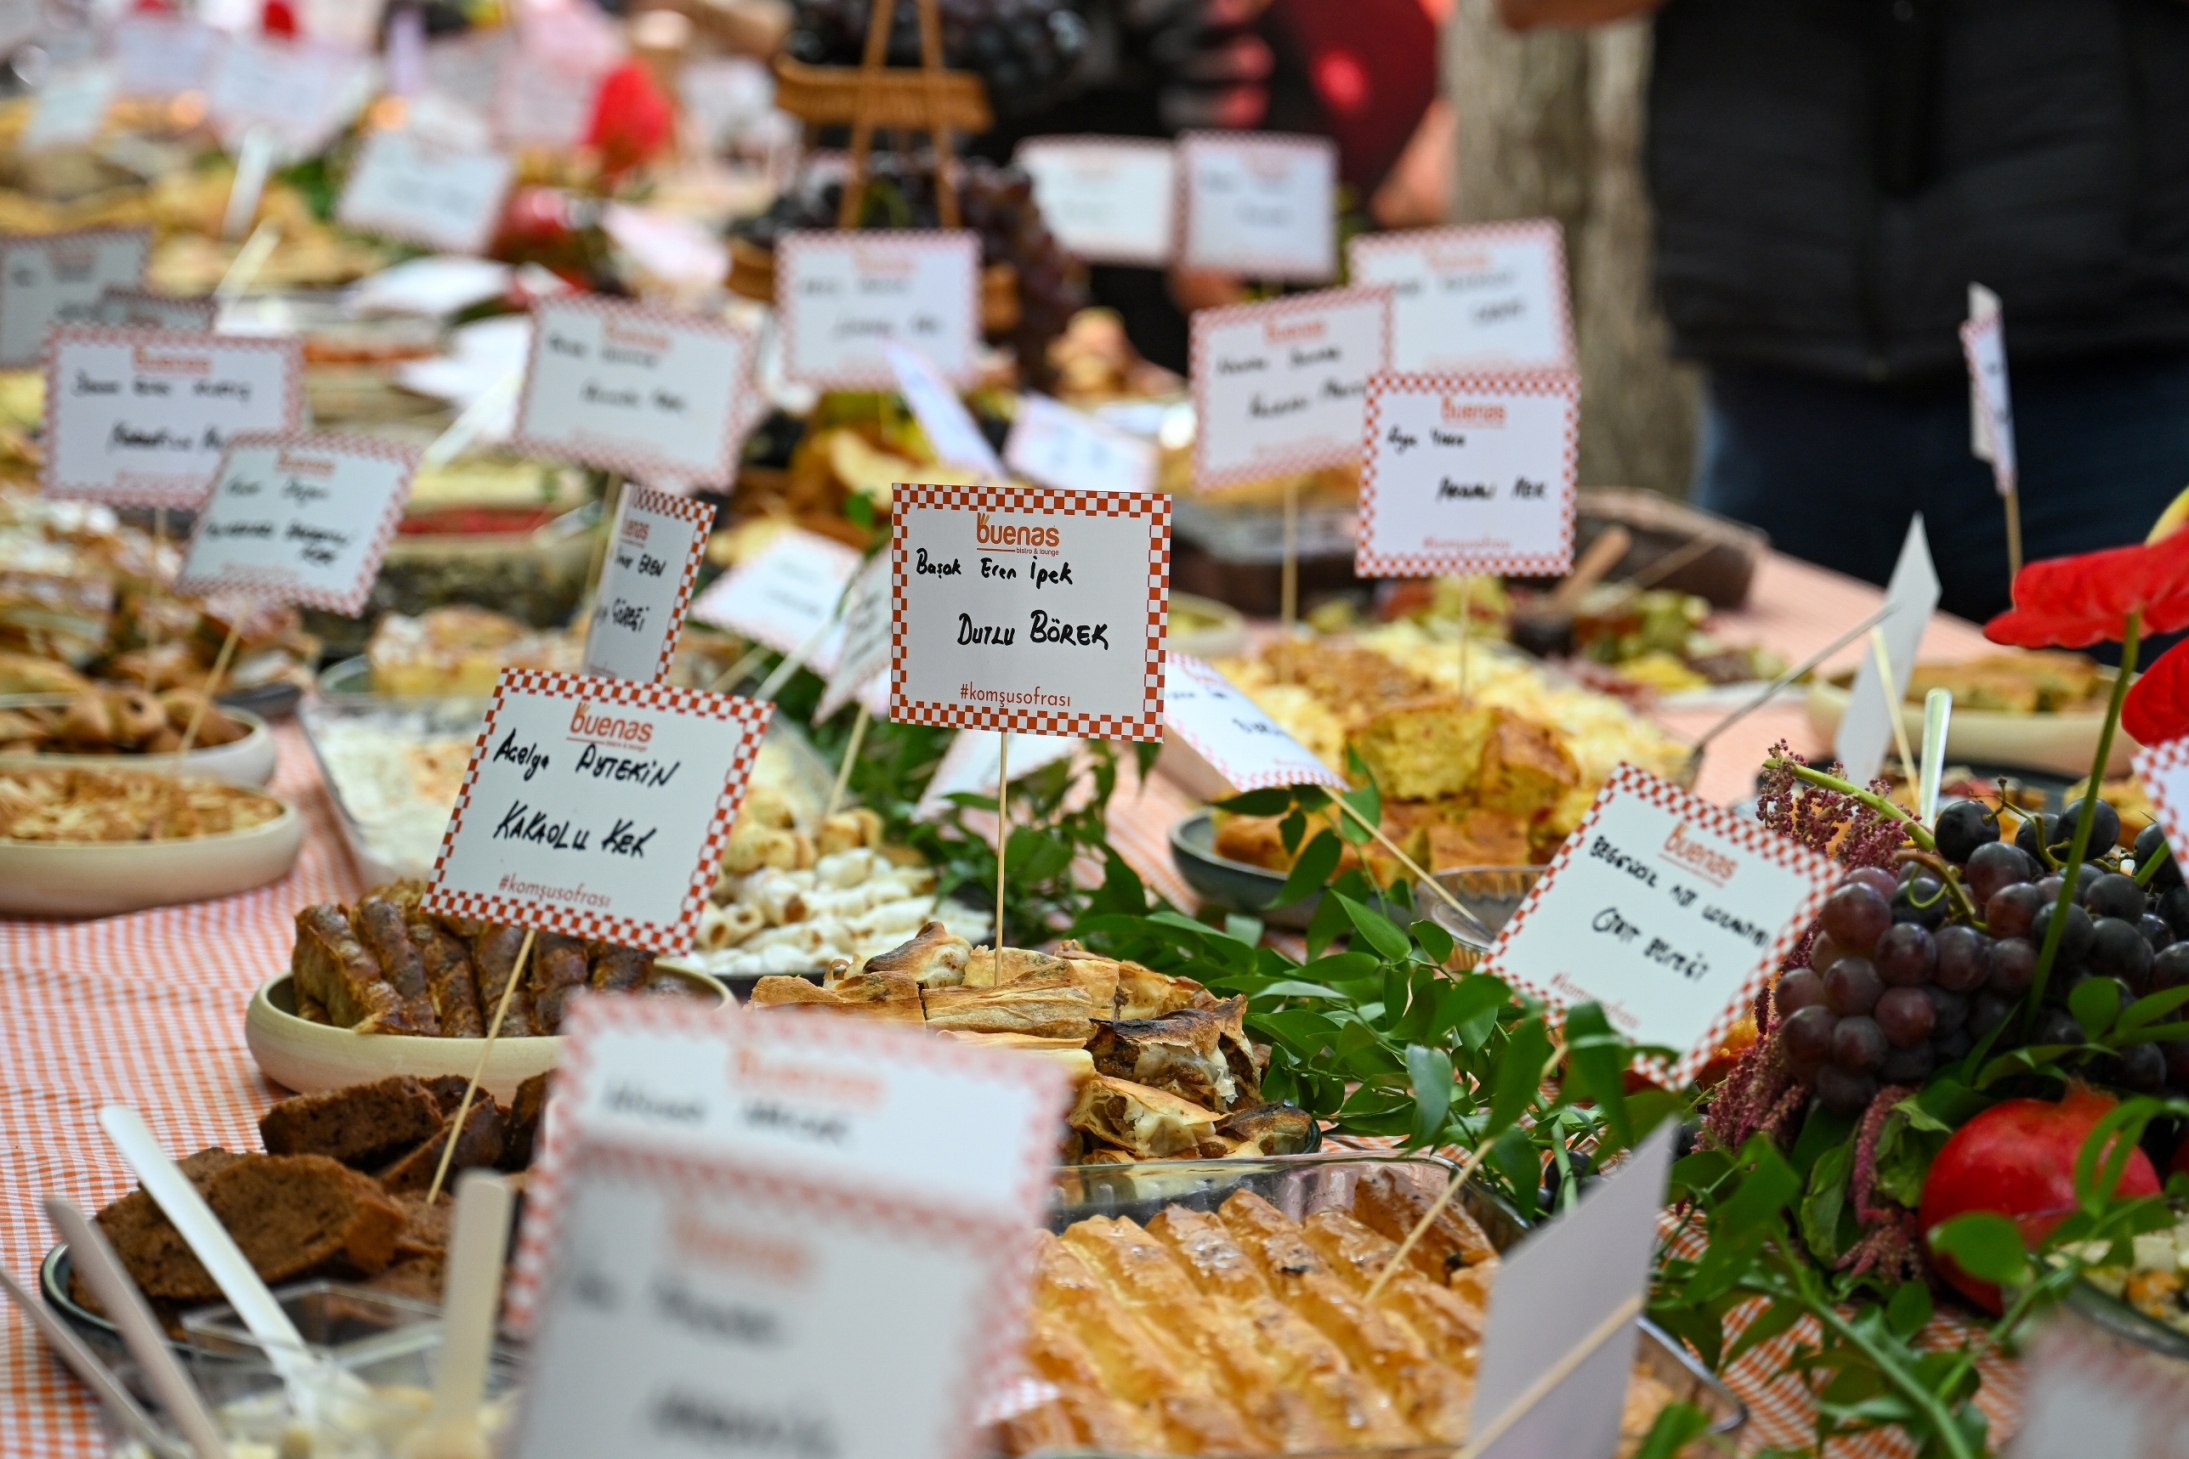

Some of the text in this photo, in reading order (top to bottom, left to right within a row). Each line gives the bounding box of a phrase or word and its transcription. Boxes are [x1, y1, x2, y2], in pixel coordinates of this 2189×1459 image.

[976, 512, 1060, 547] buenas
[916, 548, 1073, 589] Başak Eren İpek
[1039, 549, 1060, 557] lounge
[1030, 609, 1109, 650] BÖREK
[960, 681, 1071, 707] #komşusofrası
[570, 701, 654, 743] buenas
[602, 819, 656, 858] KEK
[1664, 821, 1739, 880] buenas
[498, 873, 612, 909] #komşusofrası
